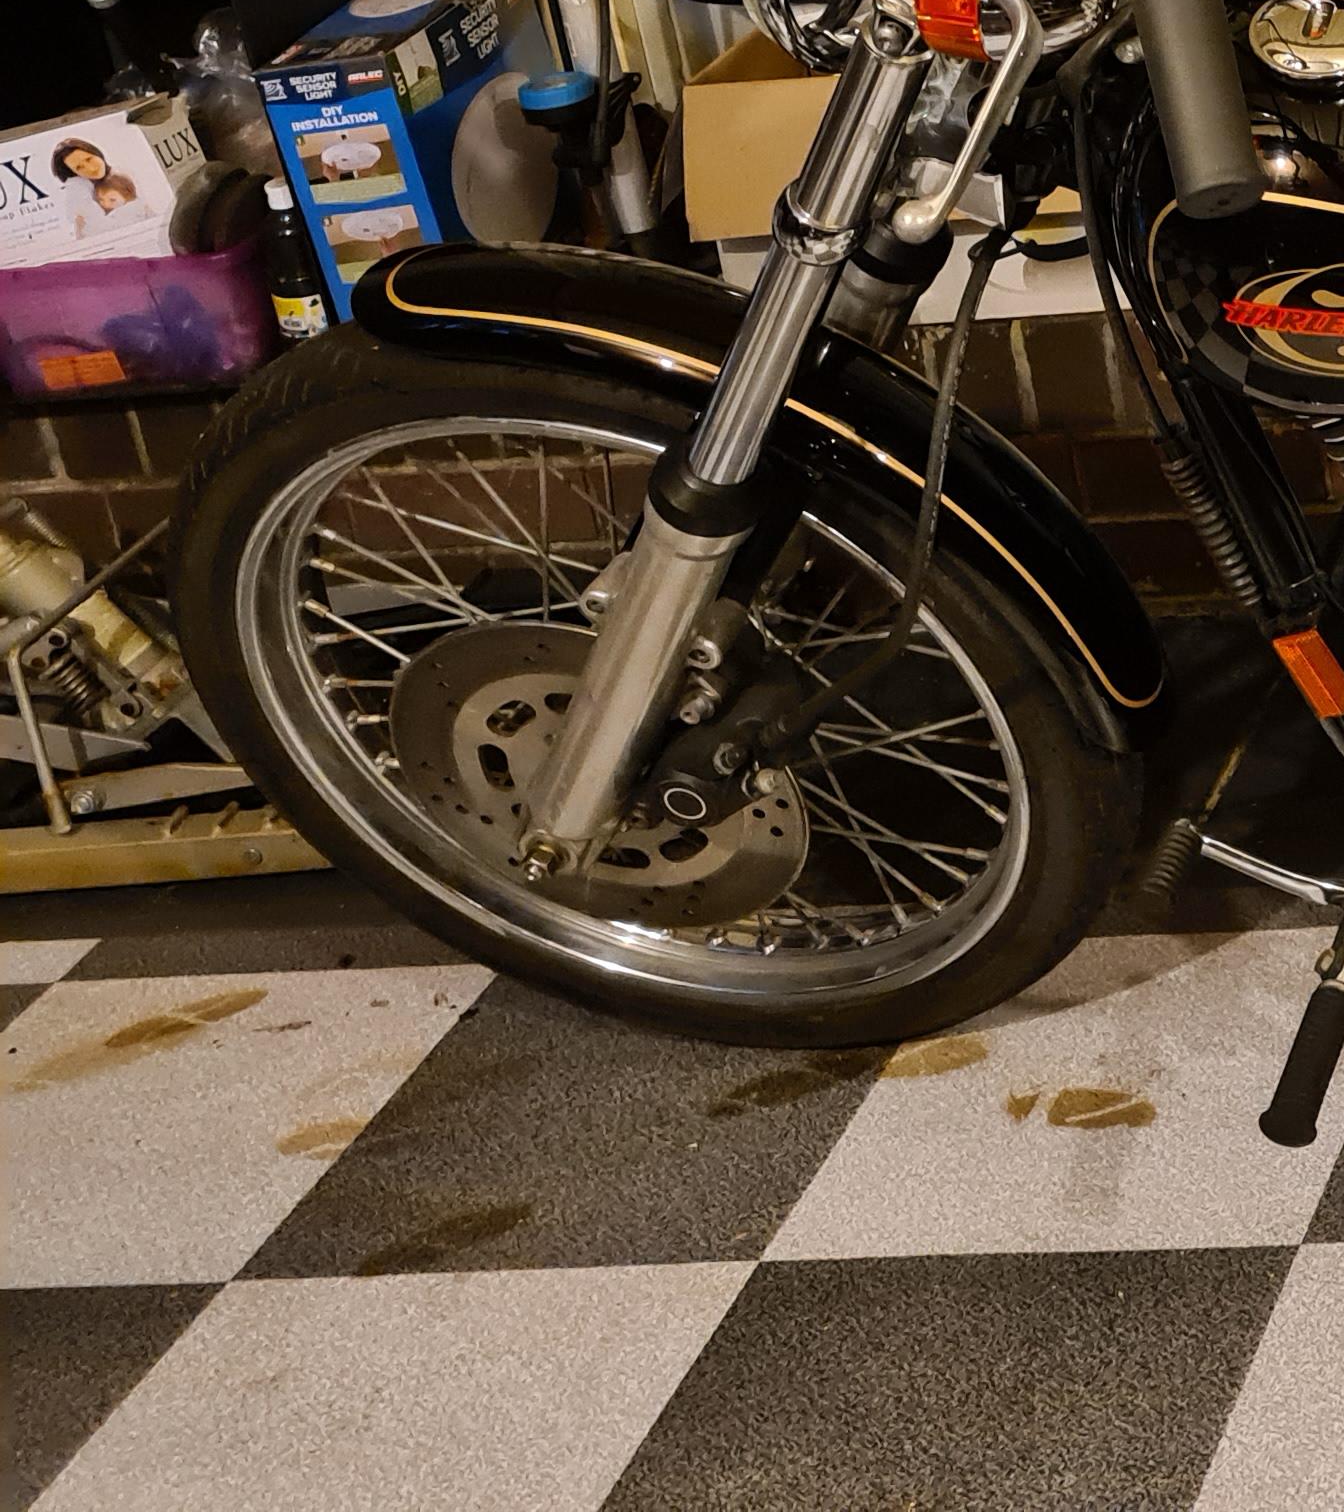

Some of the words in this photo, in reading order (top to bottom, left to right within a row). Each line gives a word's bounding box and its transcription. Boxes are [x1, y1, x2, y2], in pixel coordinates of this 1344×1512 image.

[467, 13, 500, 48] SENSOR
[476, 32, 500, 59] LIGHT
[289, 71, 337, 86] SECURITY
[295, 81, 337, 93] SENSOR
[304, 90, 334, 101] LIGHT
[320, 105, 343, 117] DIY
[291, 111, 379, 132] INSTALLATION
[154, 128, 199, 169] LUX
